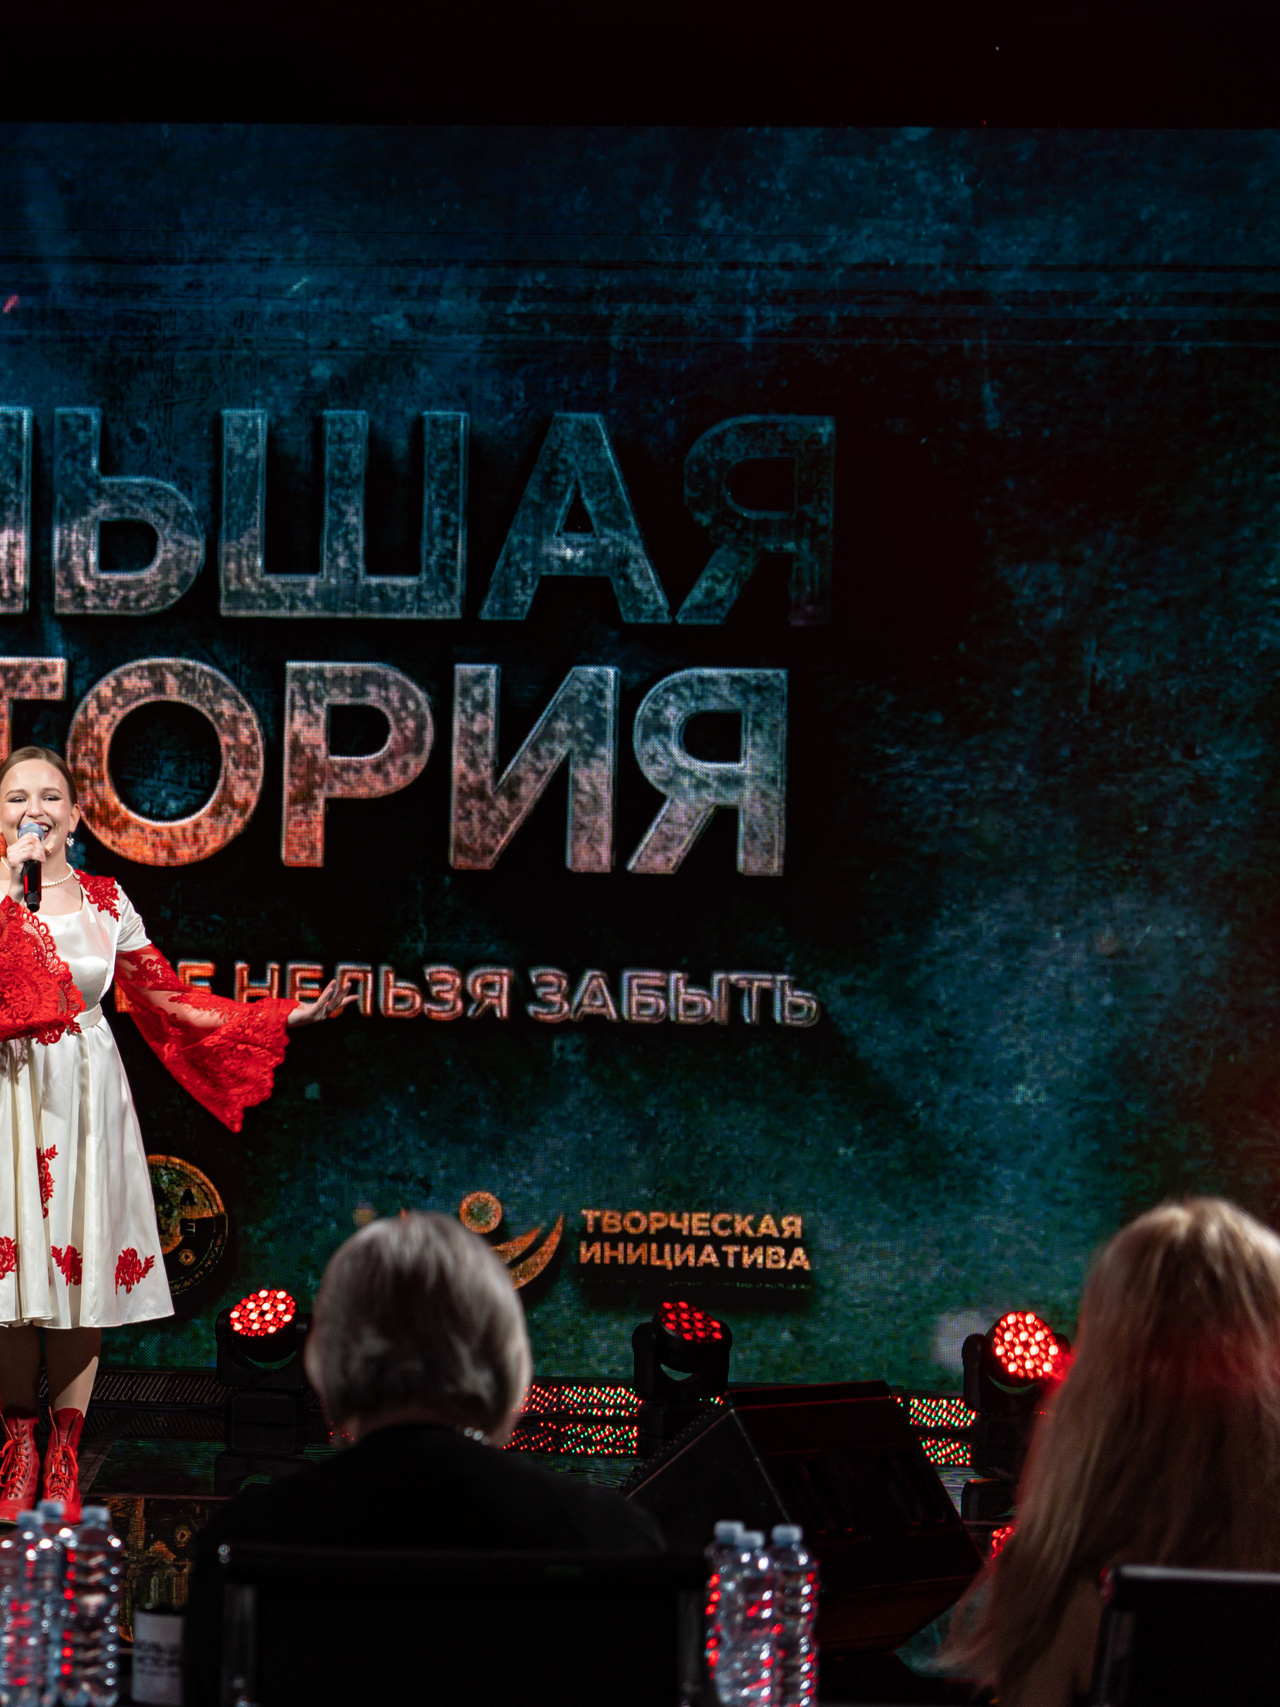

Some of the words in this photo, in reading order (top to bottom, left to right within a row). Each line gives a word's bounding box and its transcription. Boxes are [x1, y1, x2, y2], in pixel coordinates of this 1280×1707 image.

[234, 959, 515, 1021] НЕЛЬЗЯ
[527, 963, 820, 1027] ЗАБЫТЬ
[581, 1208, 803, 1240] ТВОРЧЕСКАЯ
[579, 1240, 812, 1271] ИНИЦИАТИВА
